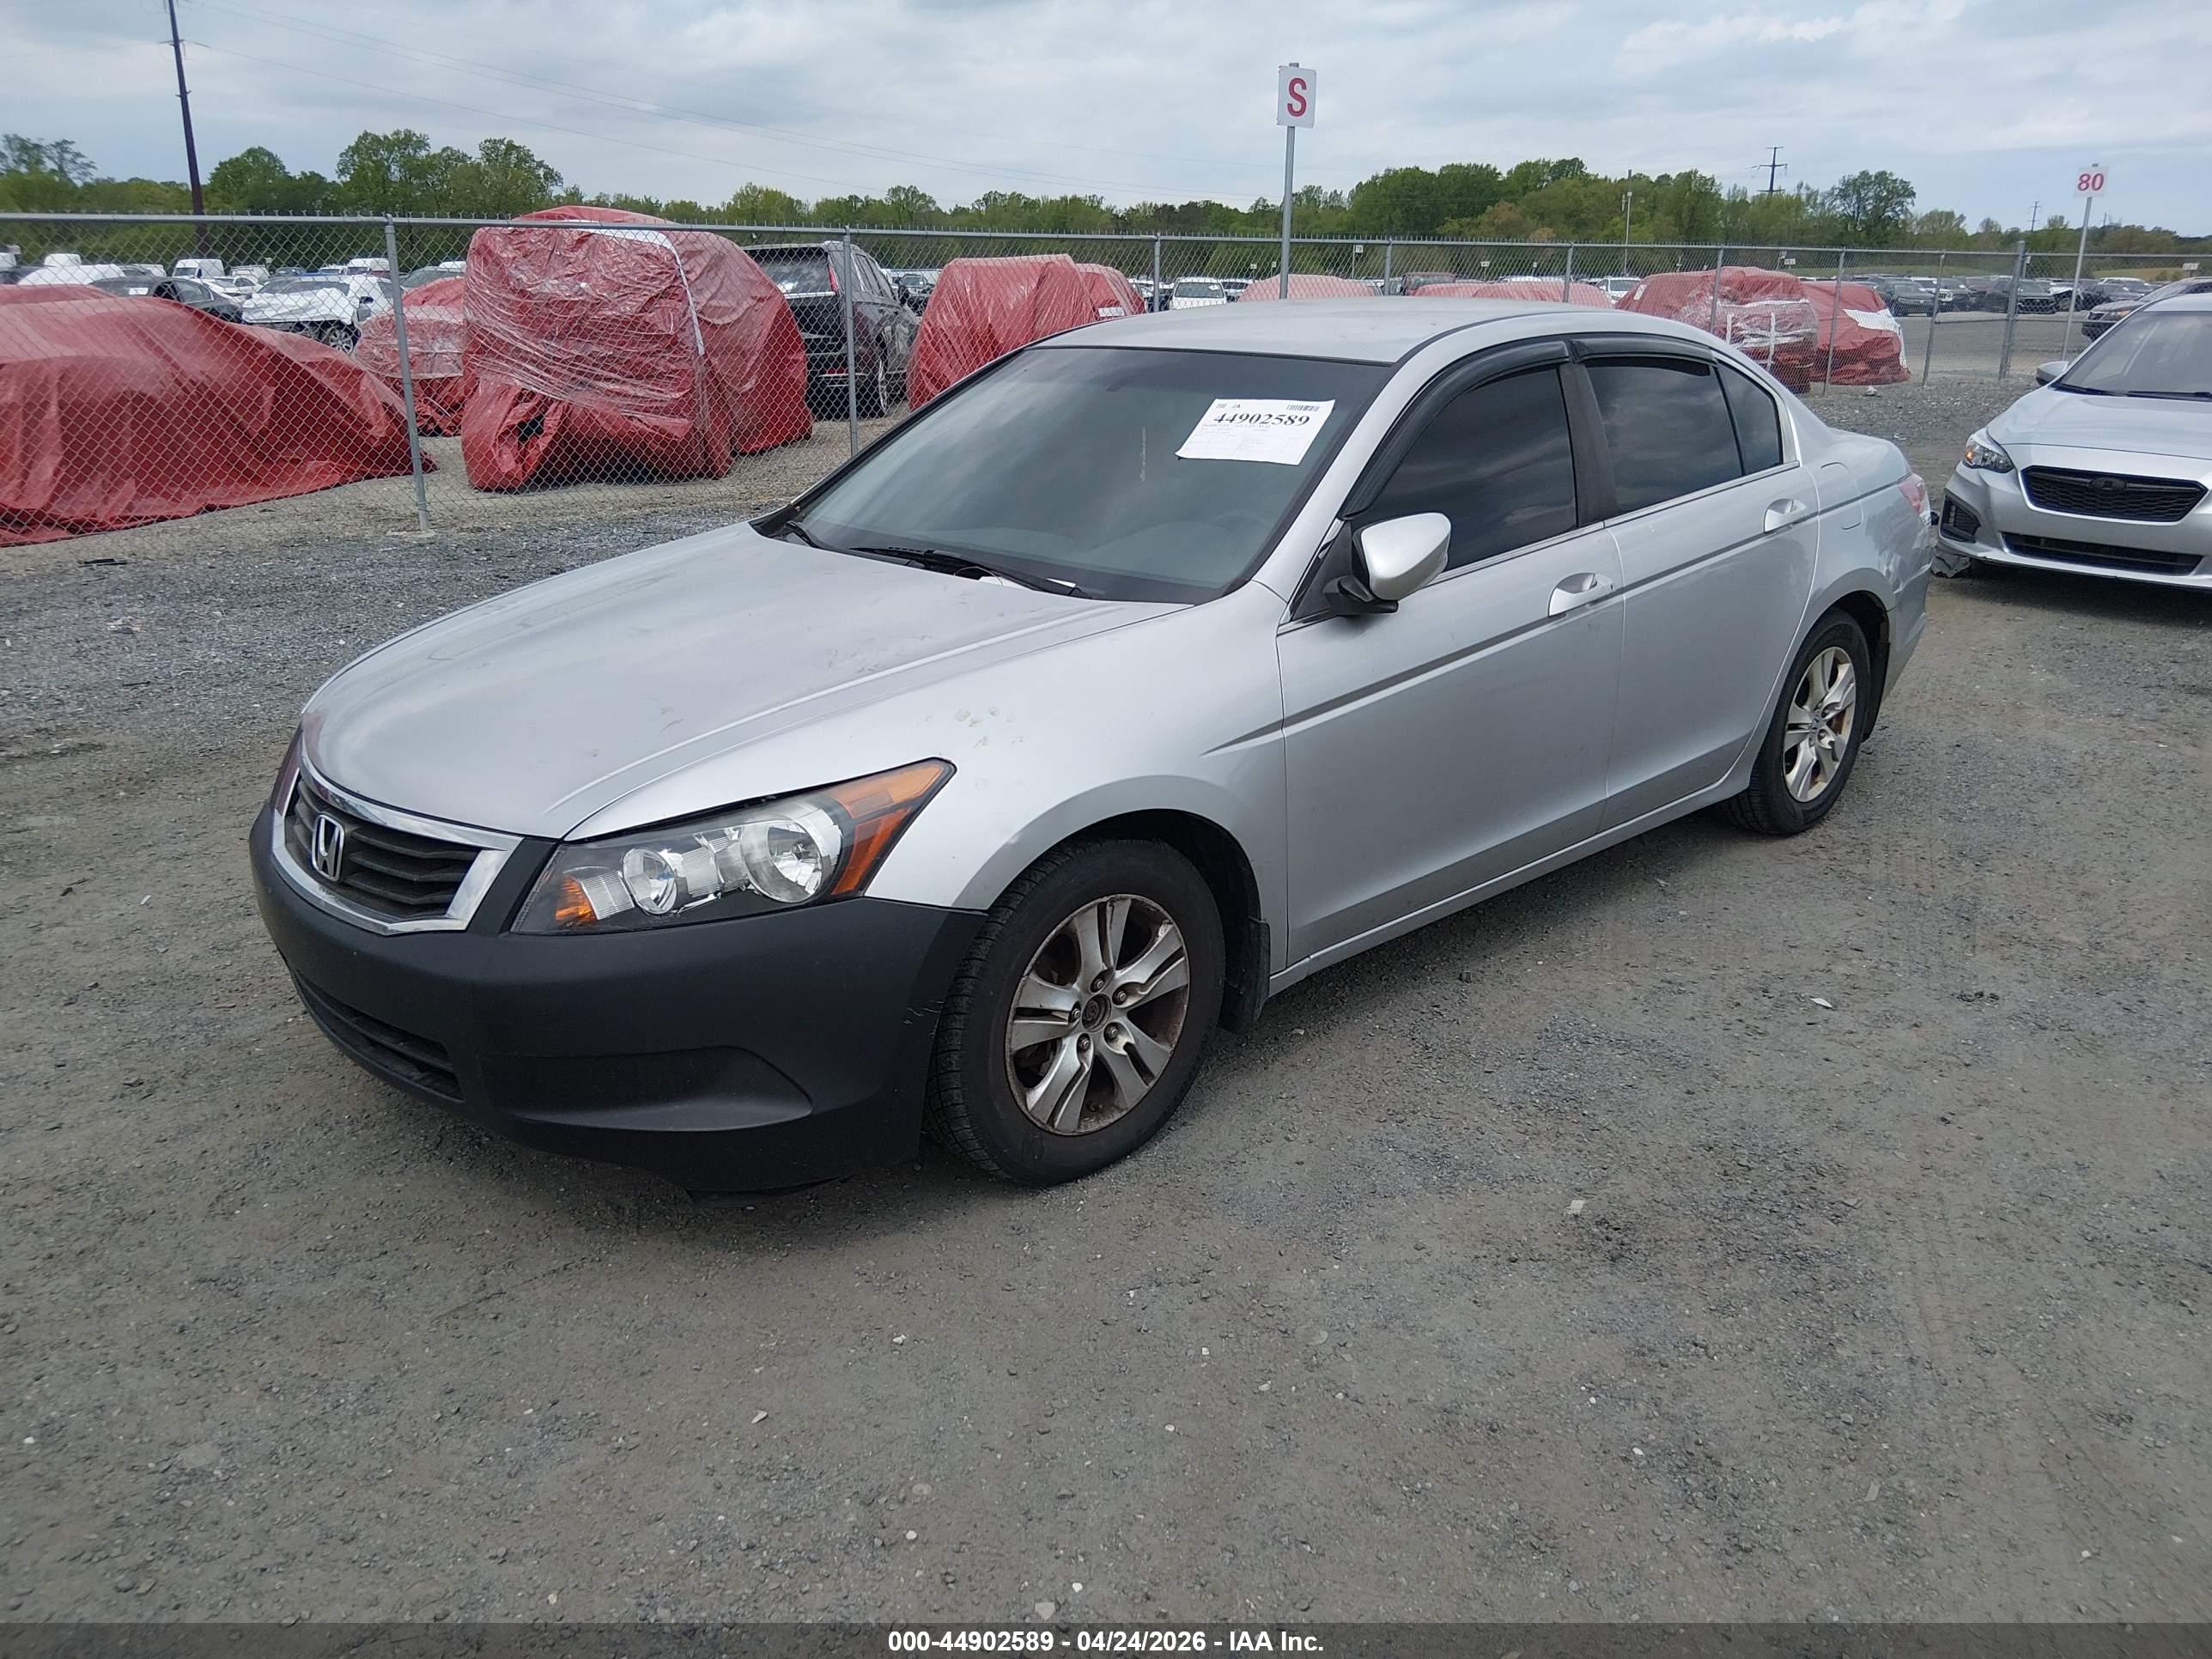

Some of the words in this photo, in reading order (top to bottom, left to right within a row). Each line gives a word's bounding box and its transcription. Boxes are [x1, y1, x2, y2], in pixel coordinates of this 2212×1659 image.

[1287, 77, 1307, 117] S
[2077, 173, 2104, 191] 80
[1213, 412, 1310, 427] 44902589
